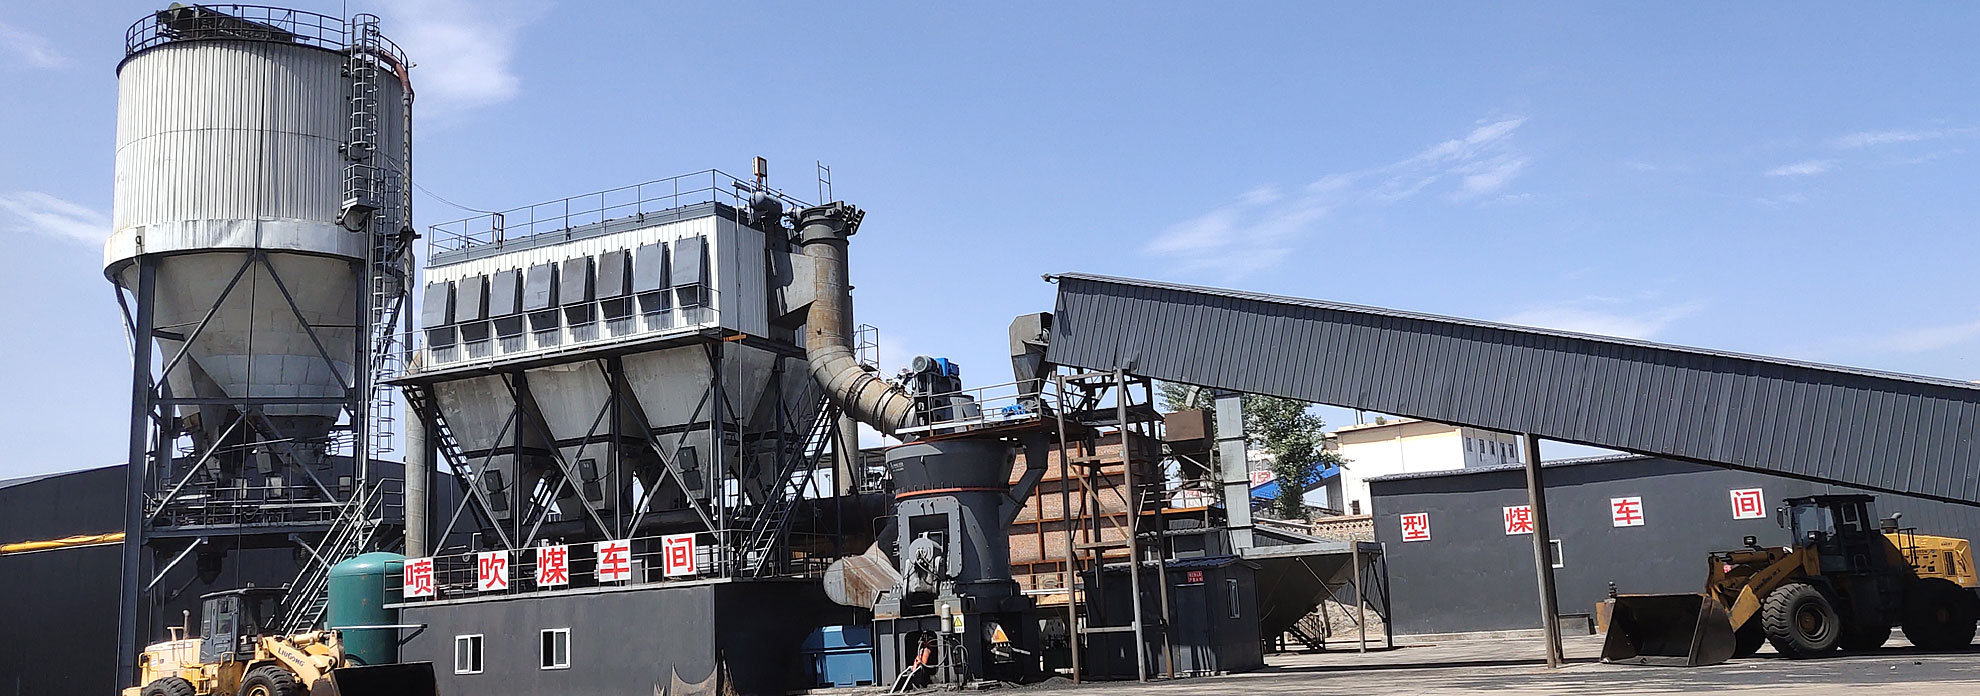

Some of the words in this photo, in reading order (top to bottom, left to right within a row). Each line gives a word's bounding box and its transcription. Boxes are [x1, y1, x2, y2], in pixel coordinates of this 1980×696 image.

[1402, 490, 1763, 540] 型煤车间
[405, 536, 694, 595] 喷吹煤车间
